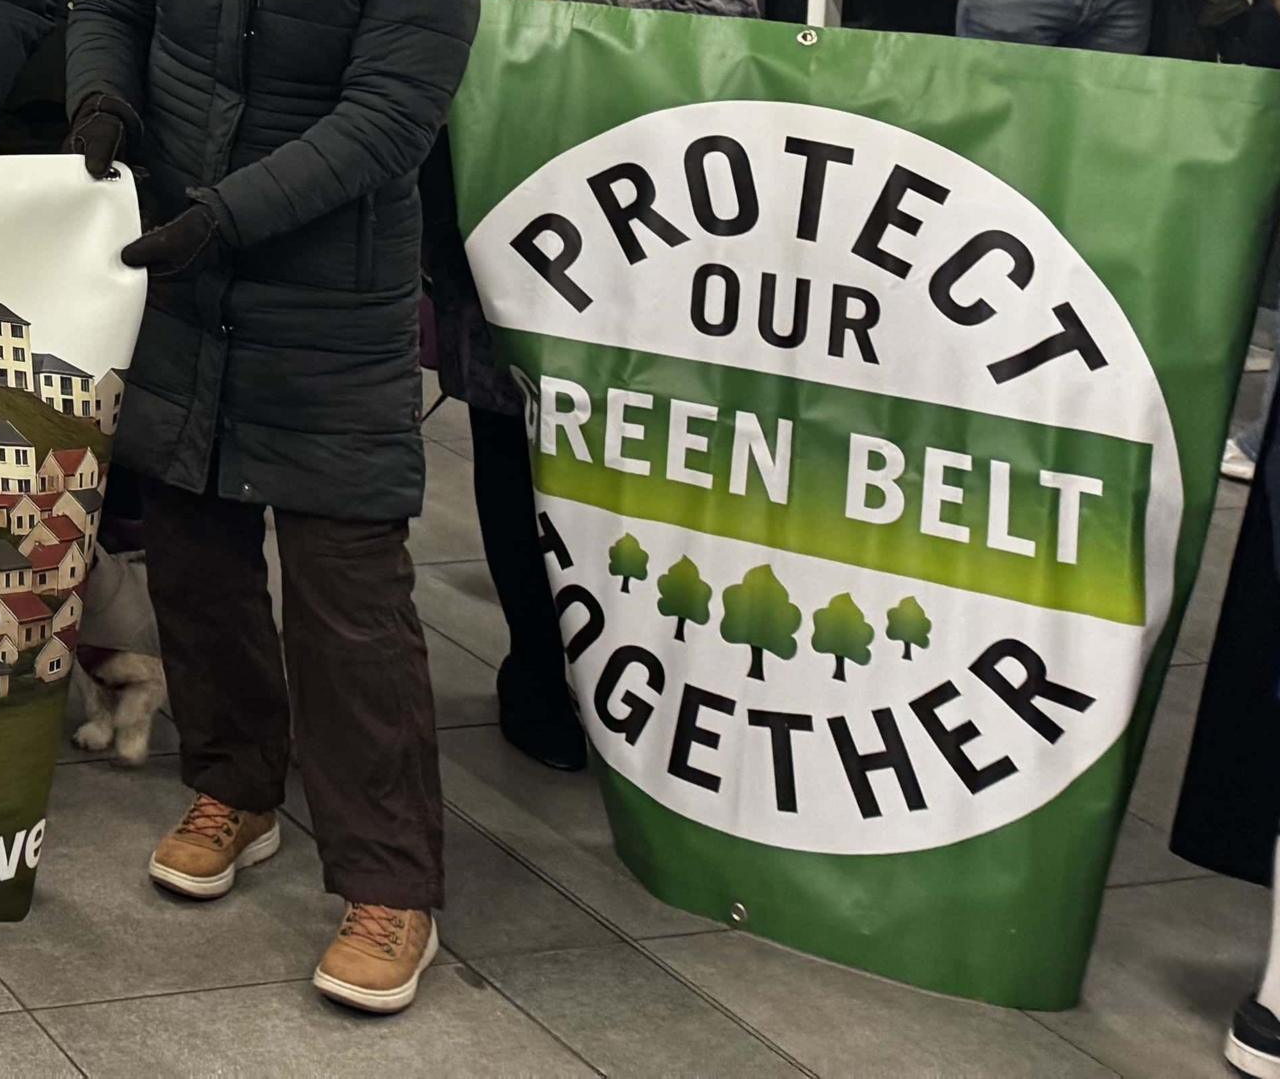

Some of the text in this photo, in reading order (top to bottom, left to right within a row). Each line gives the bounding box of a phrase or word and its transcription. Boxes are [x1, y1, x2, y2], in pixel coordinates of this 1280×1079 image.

[509, 133, 1108, 386] PROTECT
[688, 261, 883, 366] OUR
[844, 432, 1105, 566] BELT
[537, 510, 1097, 820] TOGETHER
